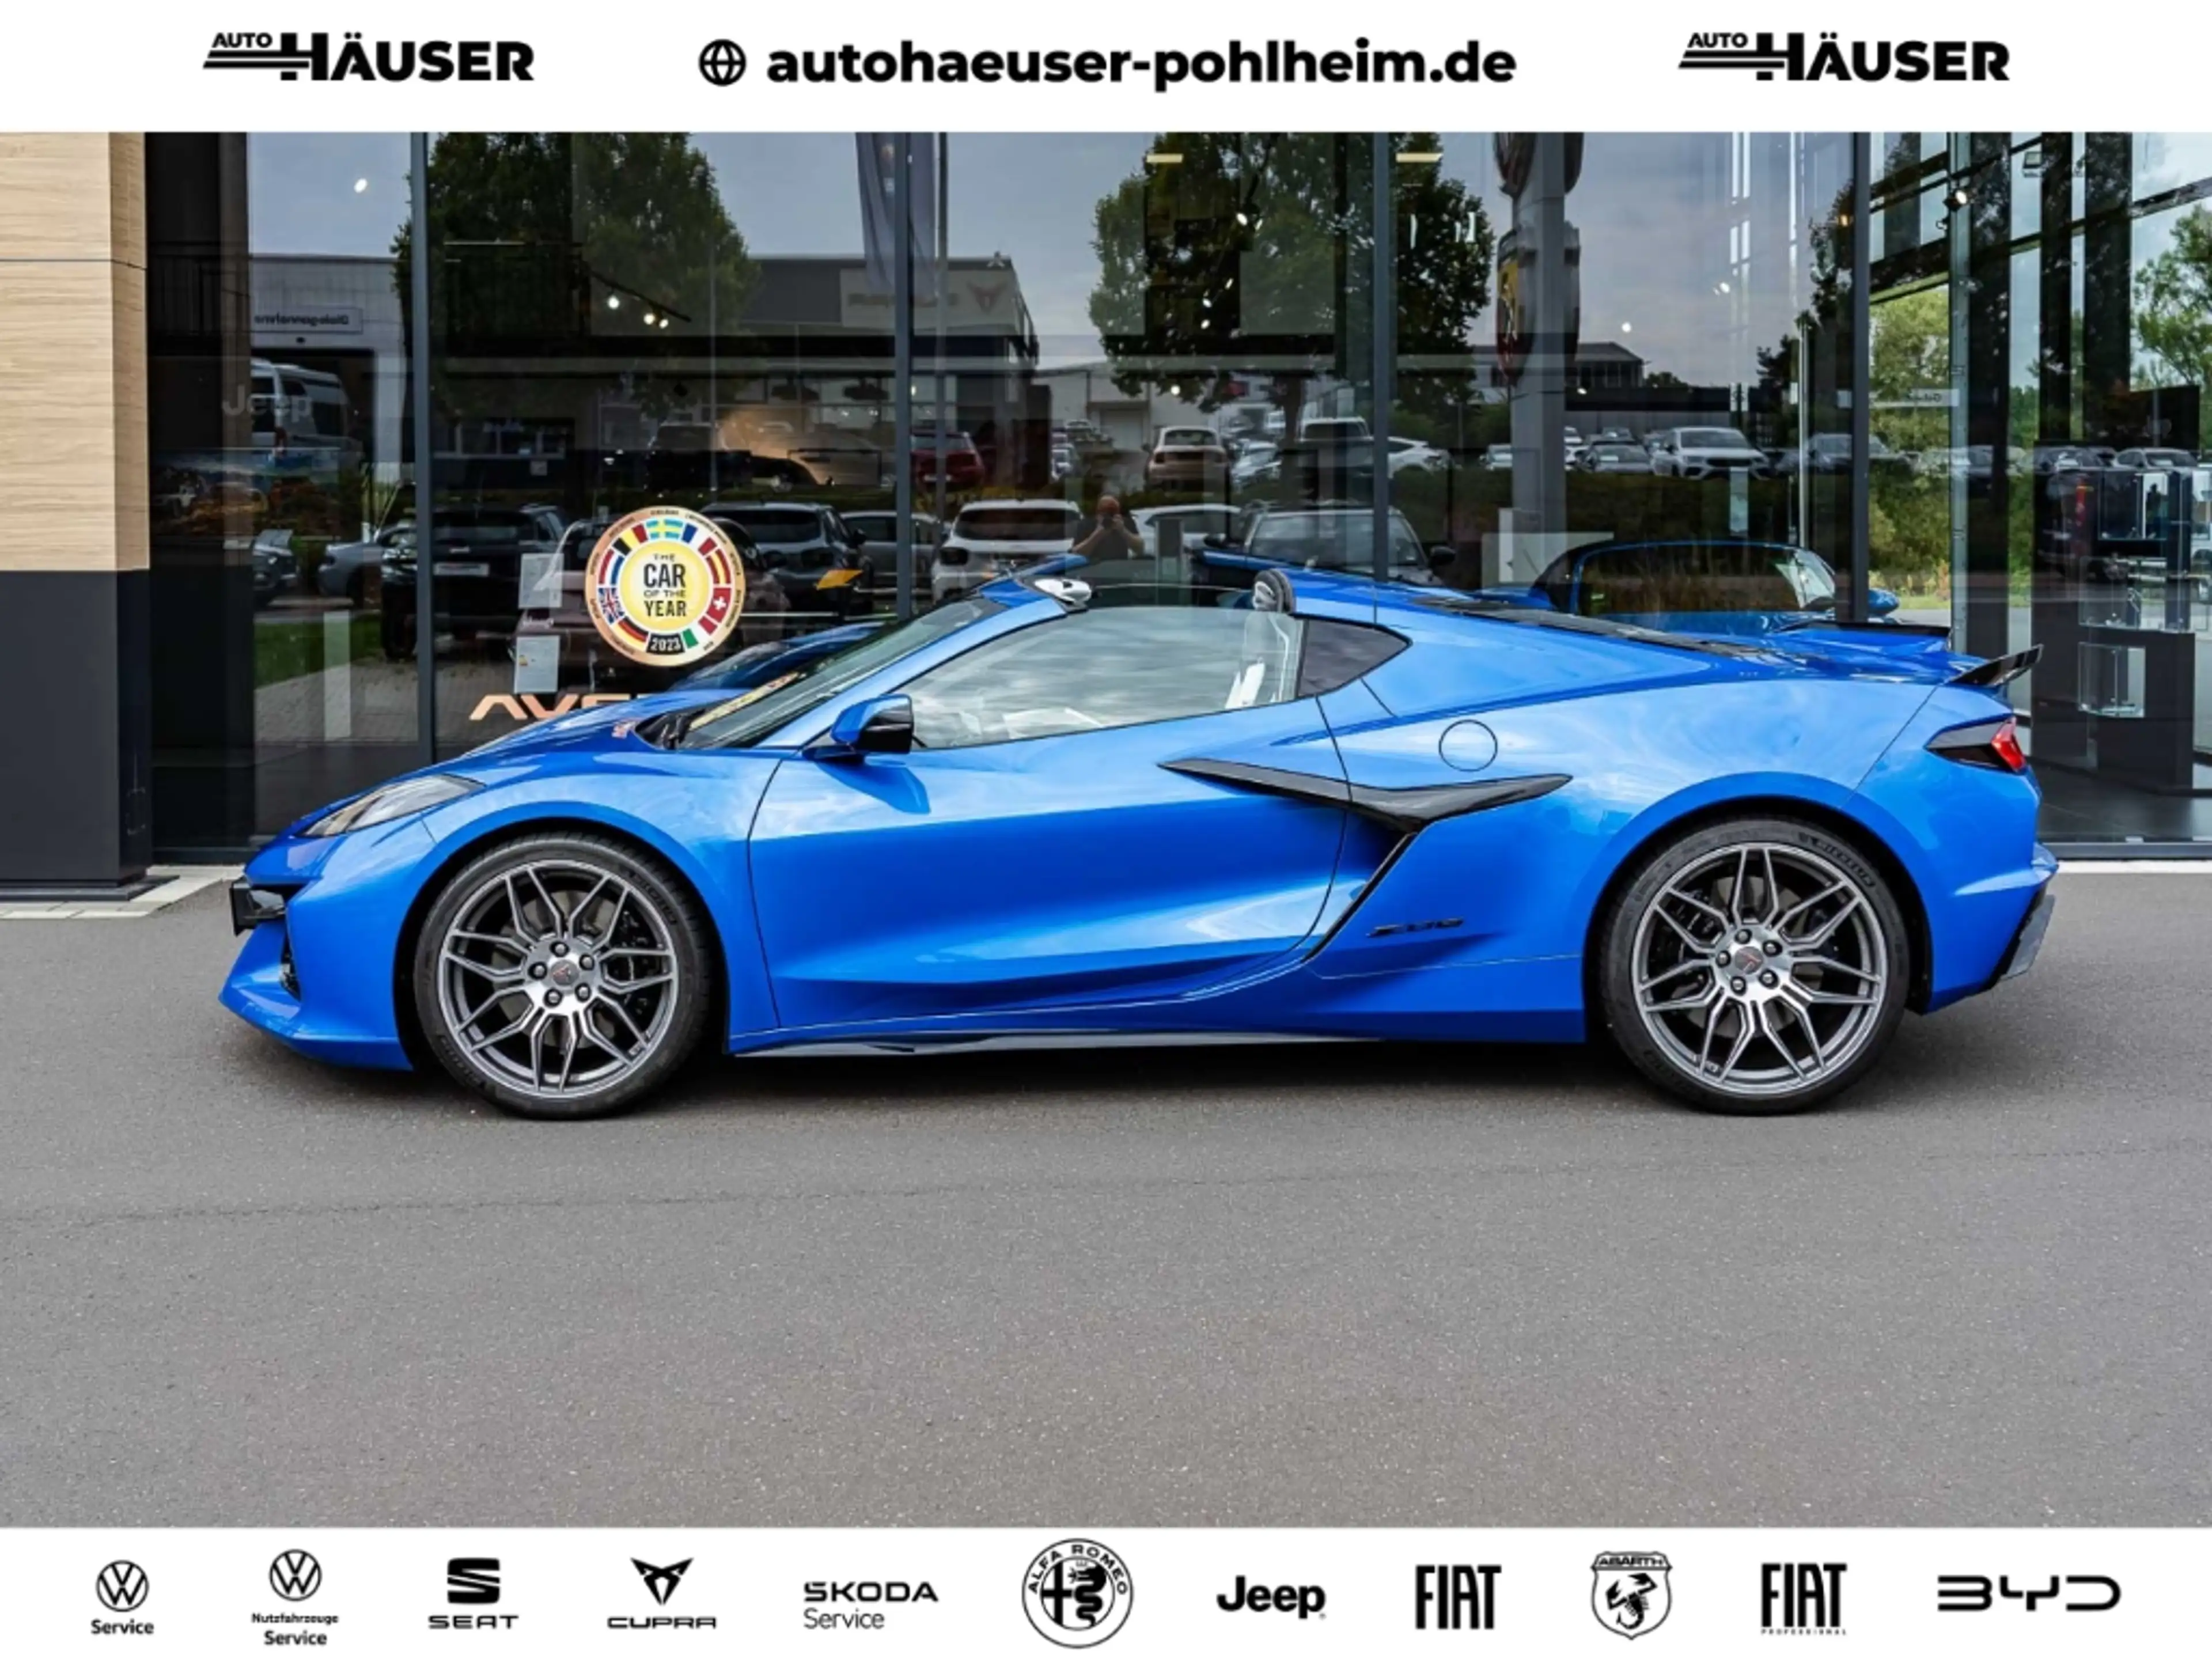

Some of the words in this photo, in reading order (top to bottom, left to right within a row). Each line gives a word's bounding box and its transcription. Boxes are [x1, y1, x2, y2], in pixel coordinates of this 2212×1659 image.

[643, 563, 686, 588] CAR
[643, 590, 660, 598] OF
[664, 590, 686, 598] THE
[644, 600, 687, 617] YEAR
[650, 638, 681, 652] 2023
